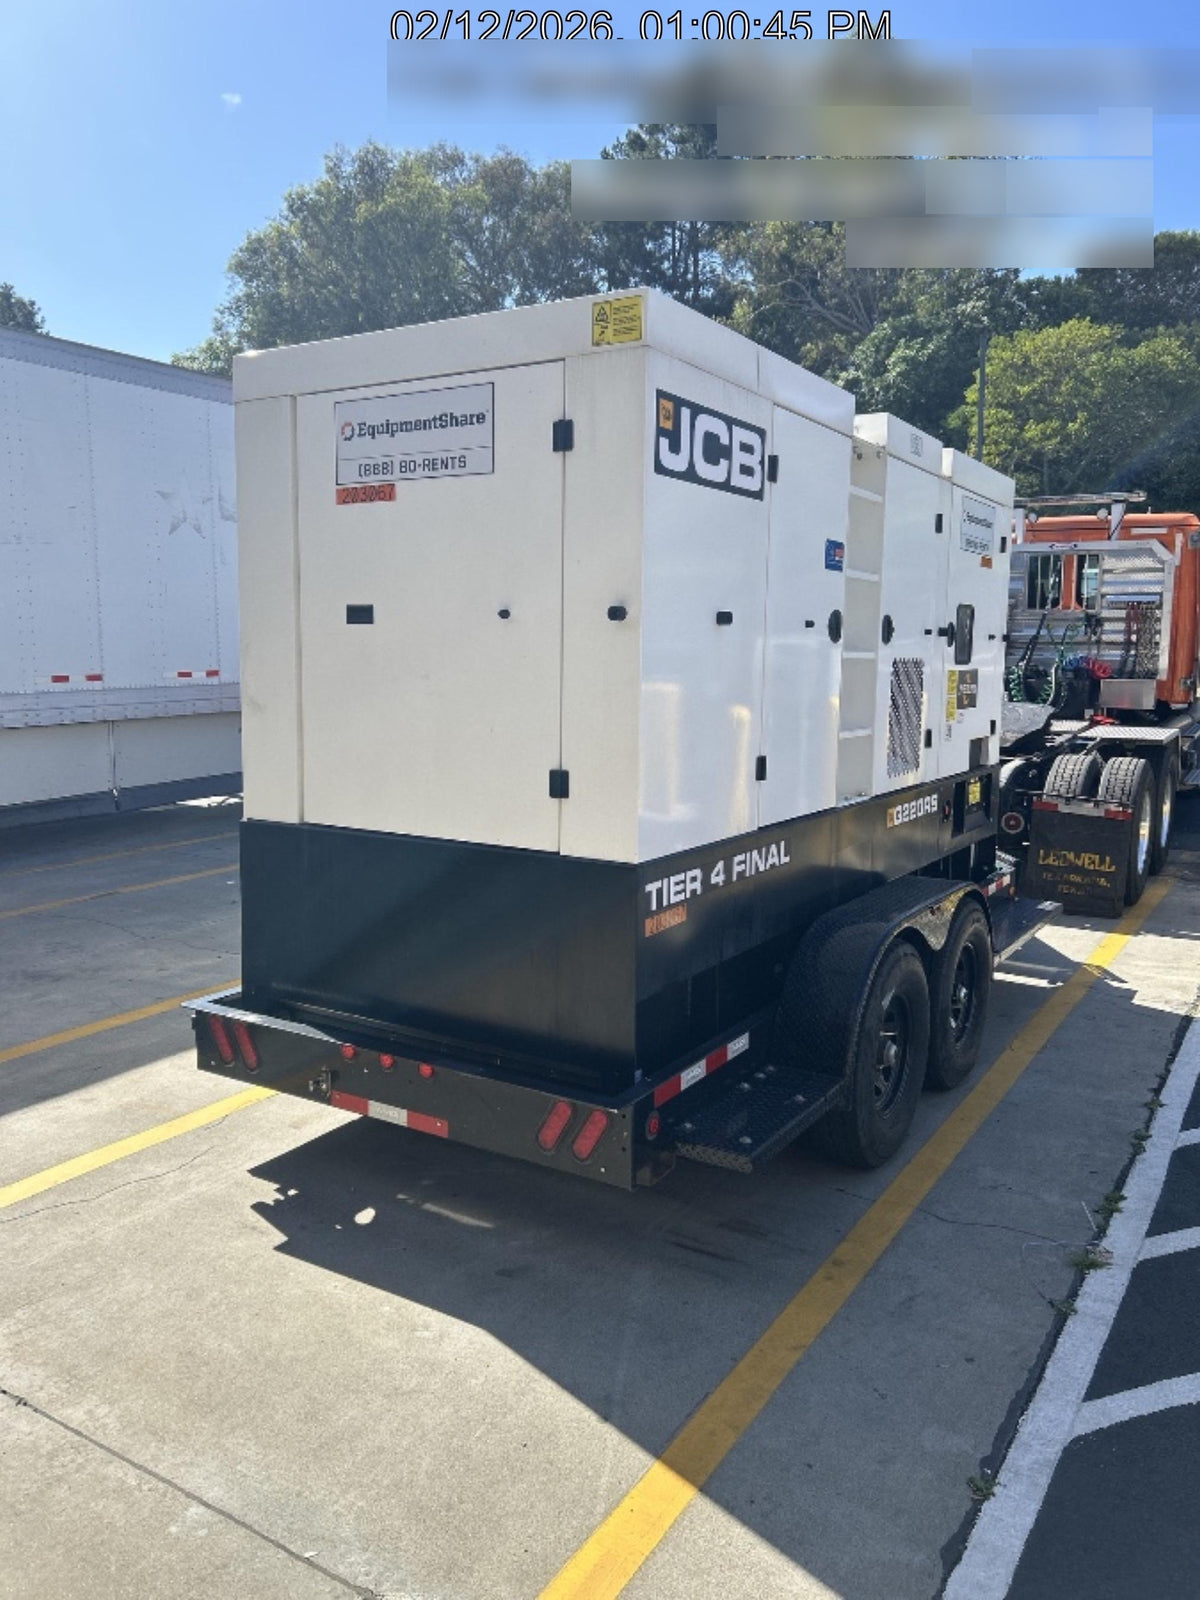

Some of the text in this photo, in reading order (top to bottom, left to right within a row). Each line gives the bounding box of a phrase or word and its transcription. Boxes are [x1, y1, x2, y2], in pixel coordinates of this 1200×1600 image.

[356, 411, 486, 440] EquipmentShare
[659, 406, 763, 492] JCB
[645, 840, 791, 911] TIER 4 FINAL
